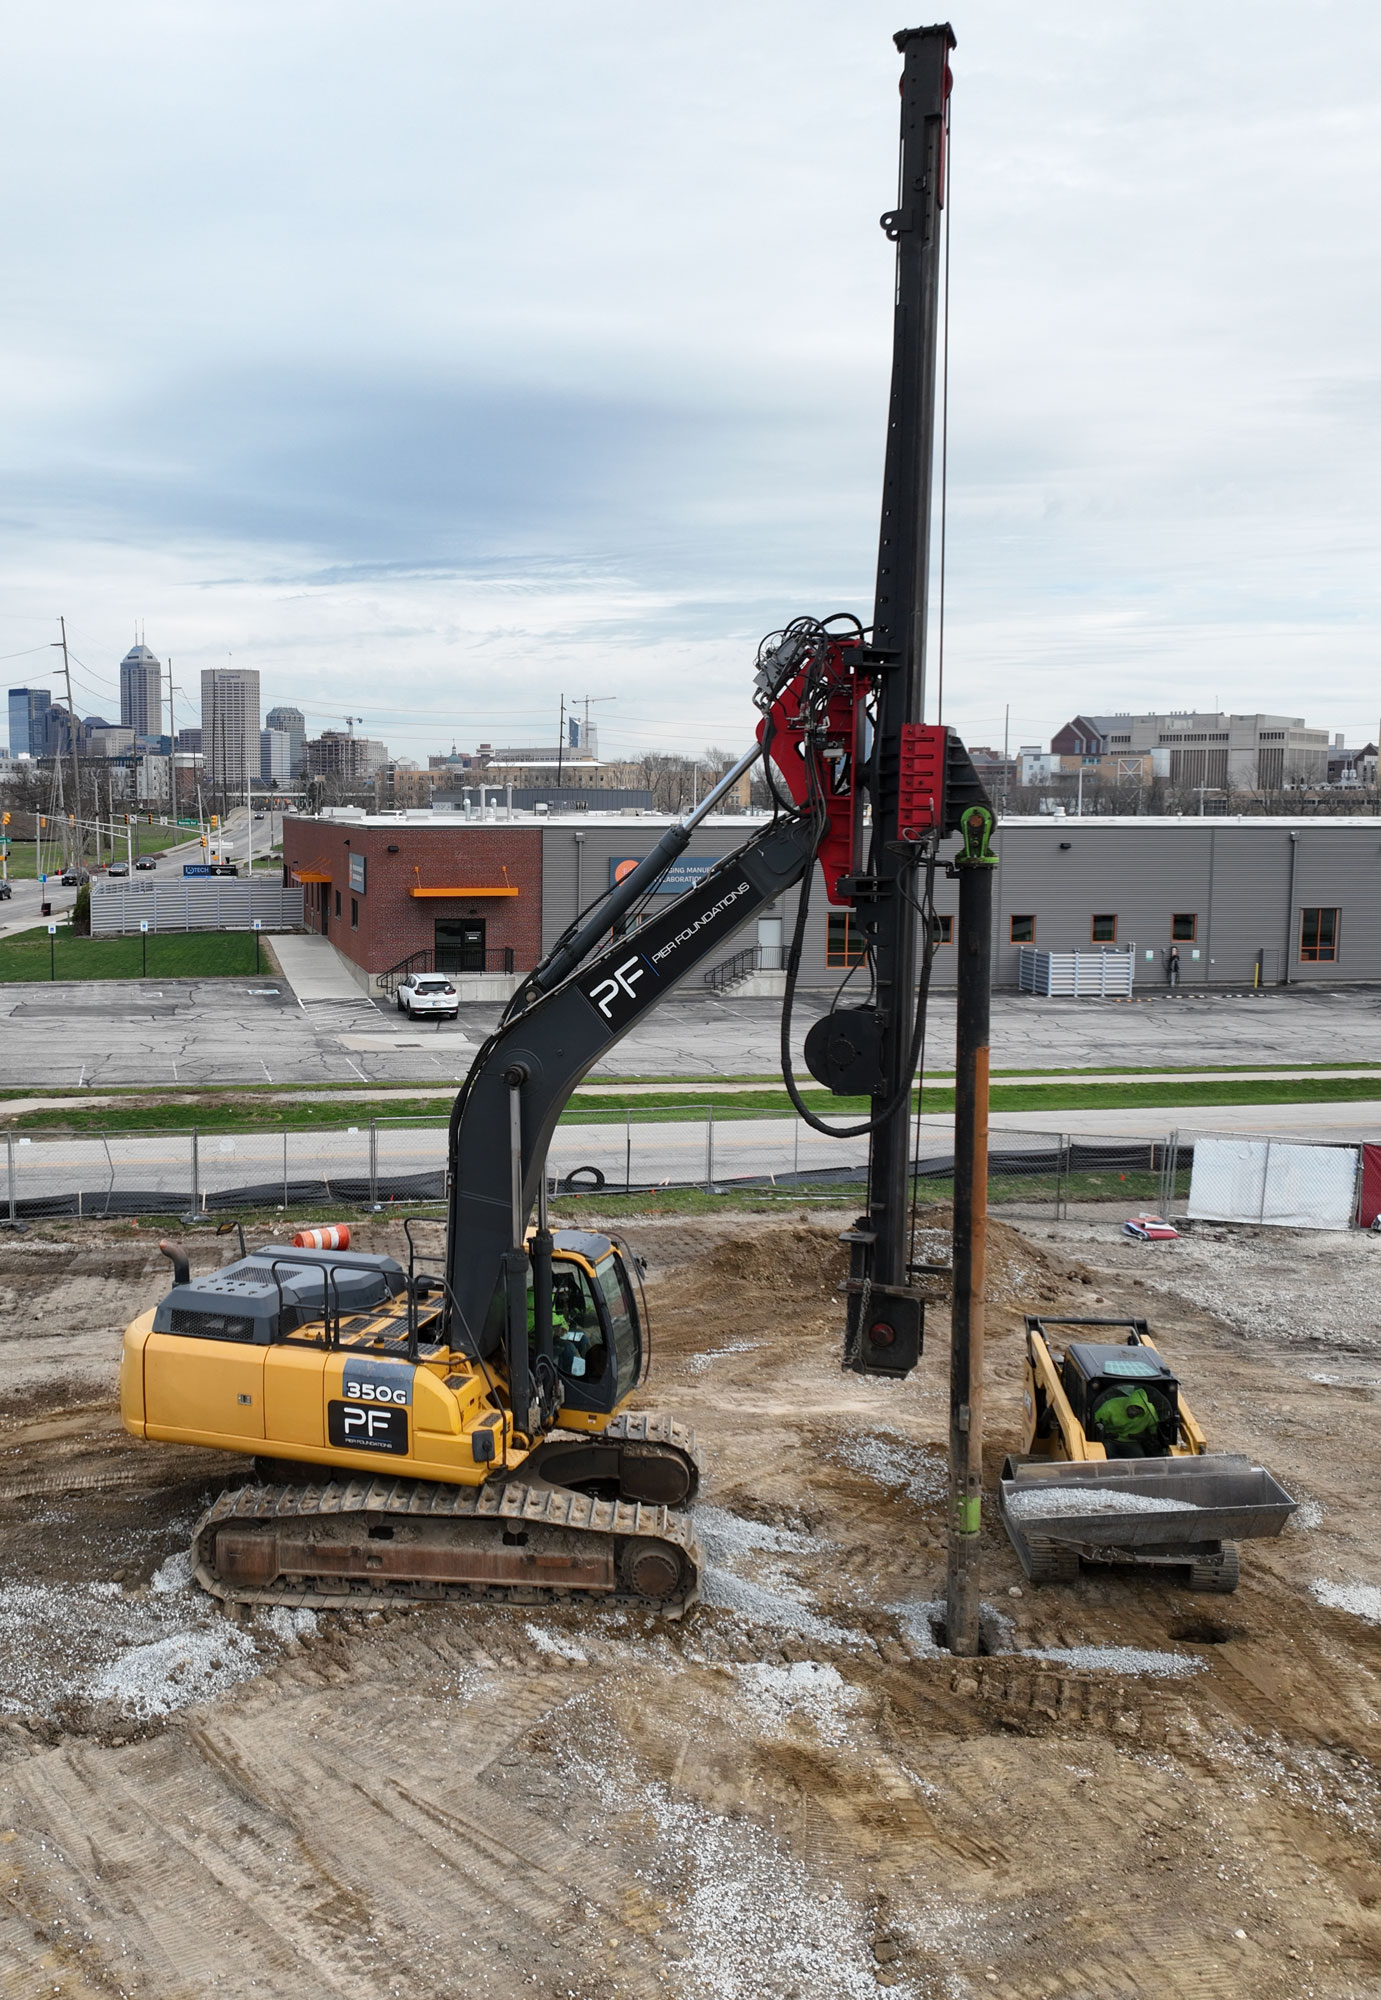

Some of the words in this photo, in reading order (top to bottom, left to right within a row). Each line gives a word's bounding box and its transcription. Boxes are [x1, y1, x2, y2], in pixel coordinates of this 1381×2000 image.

[651, 941, 677, 964] PIER
[675, 881, 750, 946] FOUNDATIONS
[589, 955, 644, 1018] PF
[347, 1382, 407, 1405] 350G
[343, 1407, 392, 1437] PF
